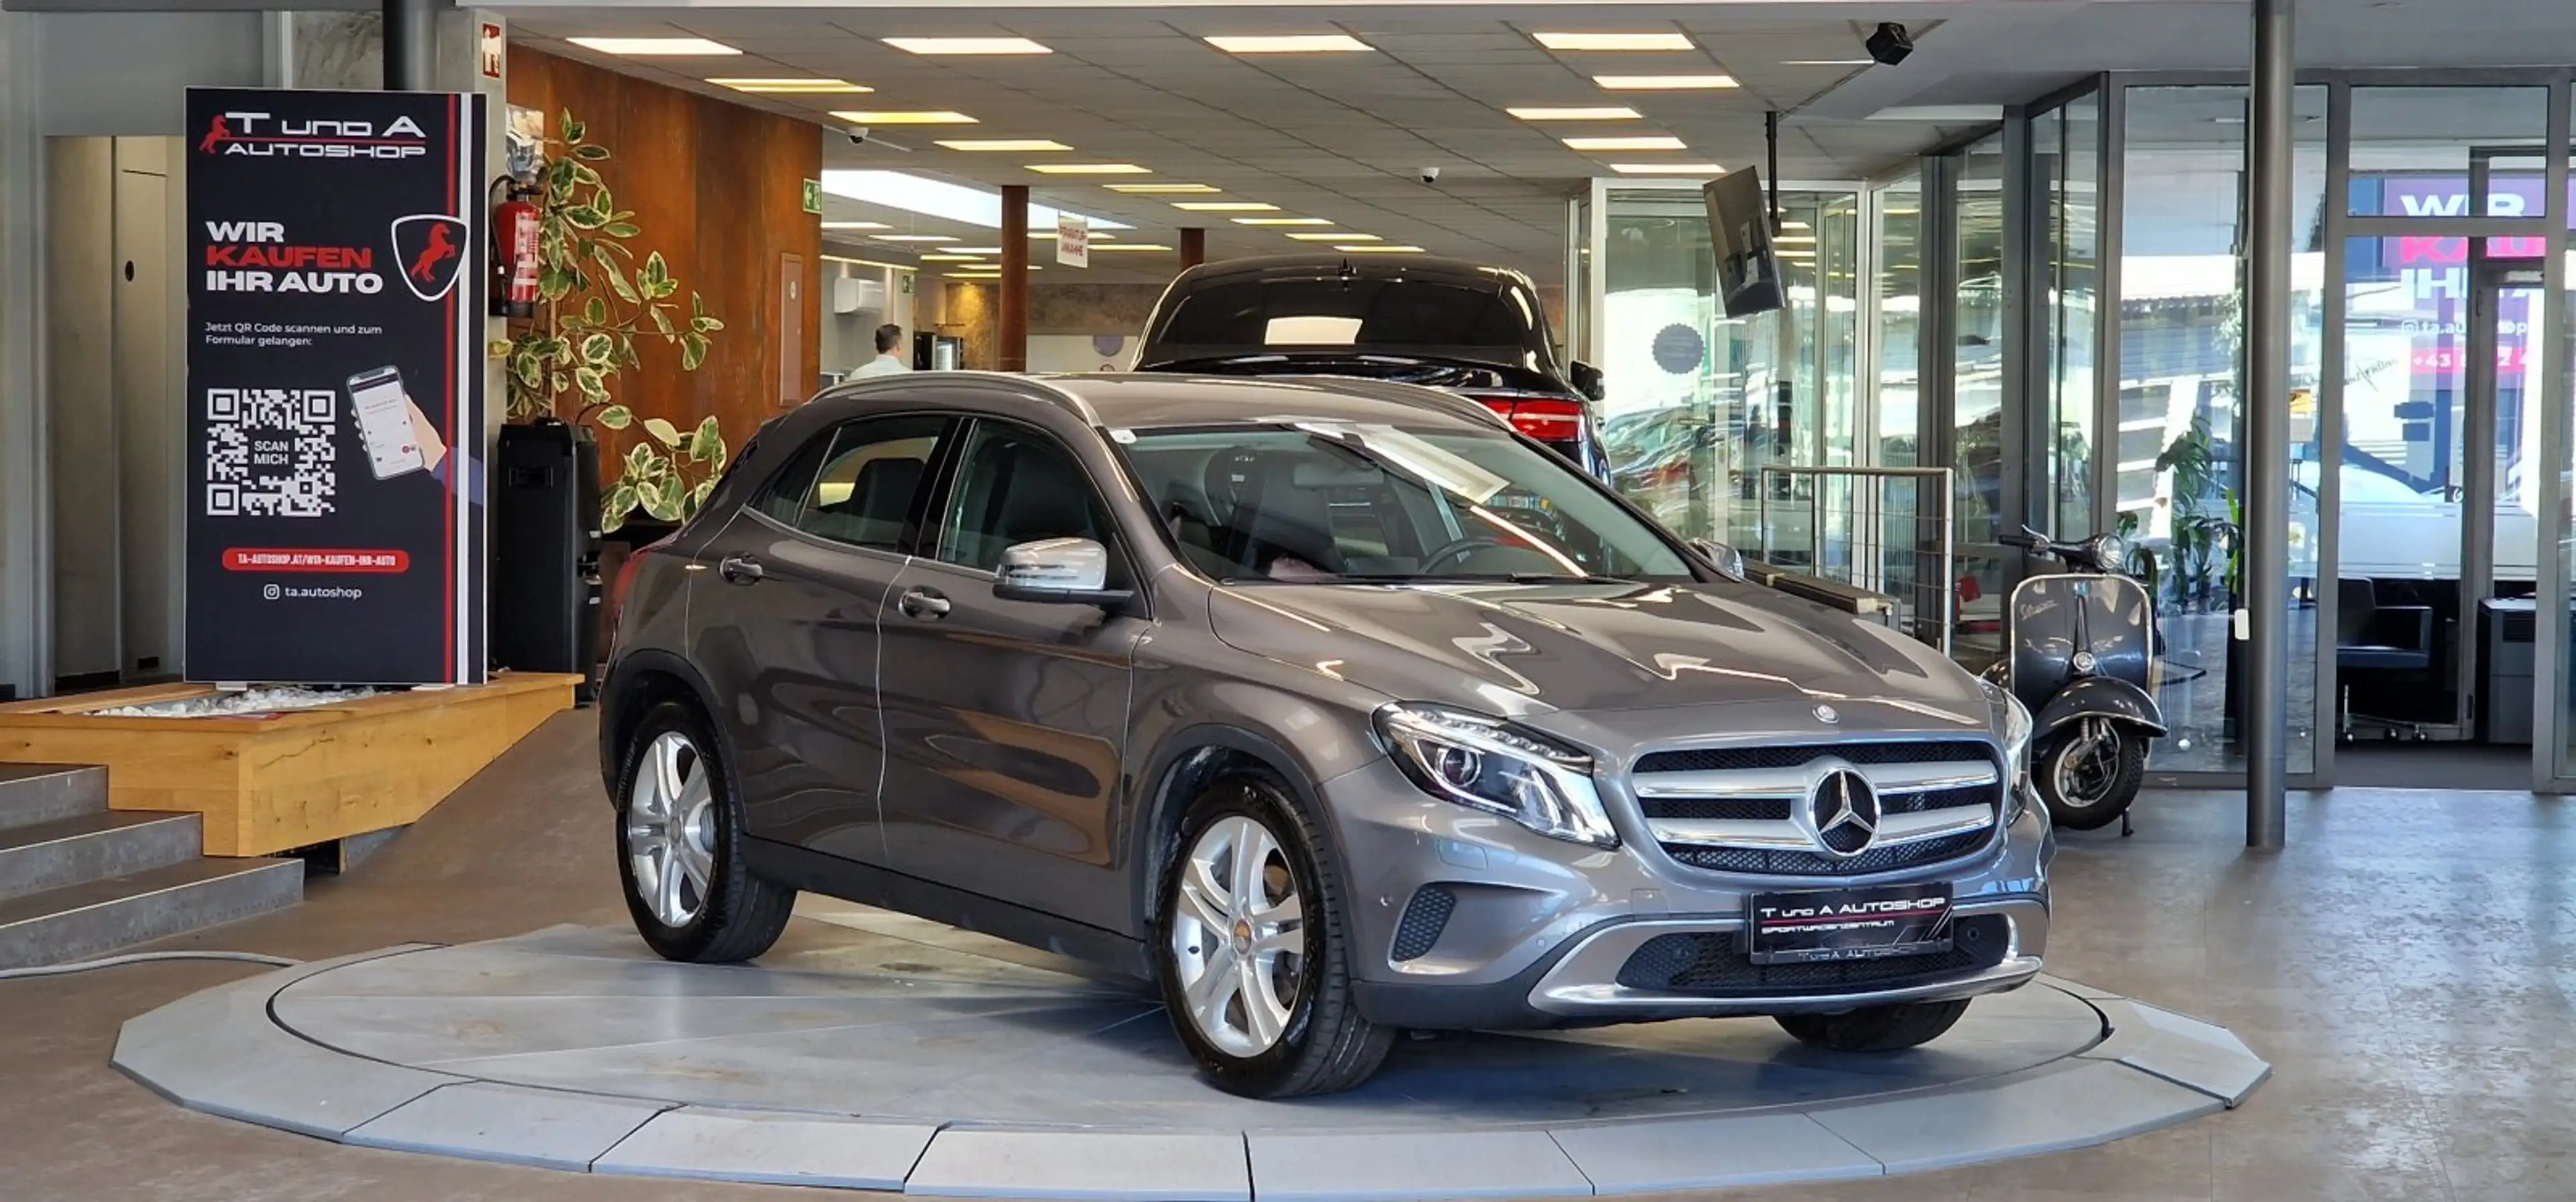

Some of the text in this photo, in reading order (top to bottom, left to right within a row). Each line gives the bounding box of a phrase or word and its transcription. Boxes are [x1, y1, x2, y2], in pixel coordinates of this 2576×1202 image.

[225, 112, 270, 133] T
[382, 115, 427, 138] A
[225, 143, 426, 158] AUTOSHOP
[206, 221, 284, 242] WIR
[207, 246, 372, 268] KAUFEN
[207, 271, 383, 294] IHR AUTO
[205, 322, 382, 335] Jetzt QR Code scannen und zum
[206, 335, 255, 344] Formular
[254, 440, 288, 451] SCAN
[254, 453, 288, 464] MICH
[285, 586, 362, 599] ta.autoshop
[1760, 908, 1776, 918] T
[1819, 905, 1833, 915] A
[1839, 897, 1945, 914] AUTOSHOP
